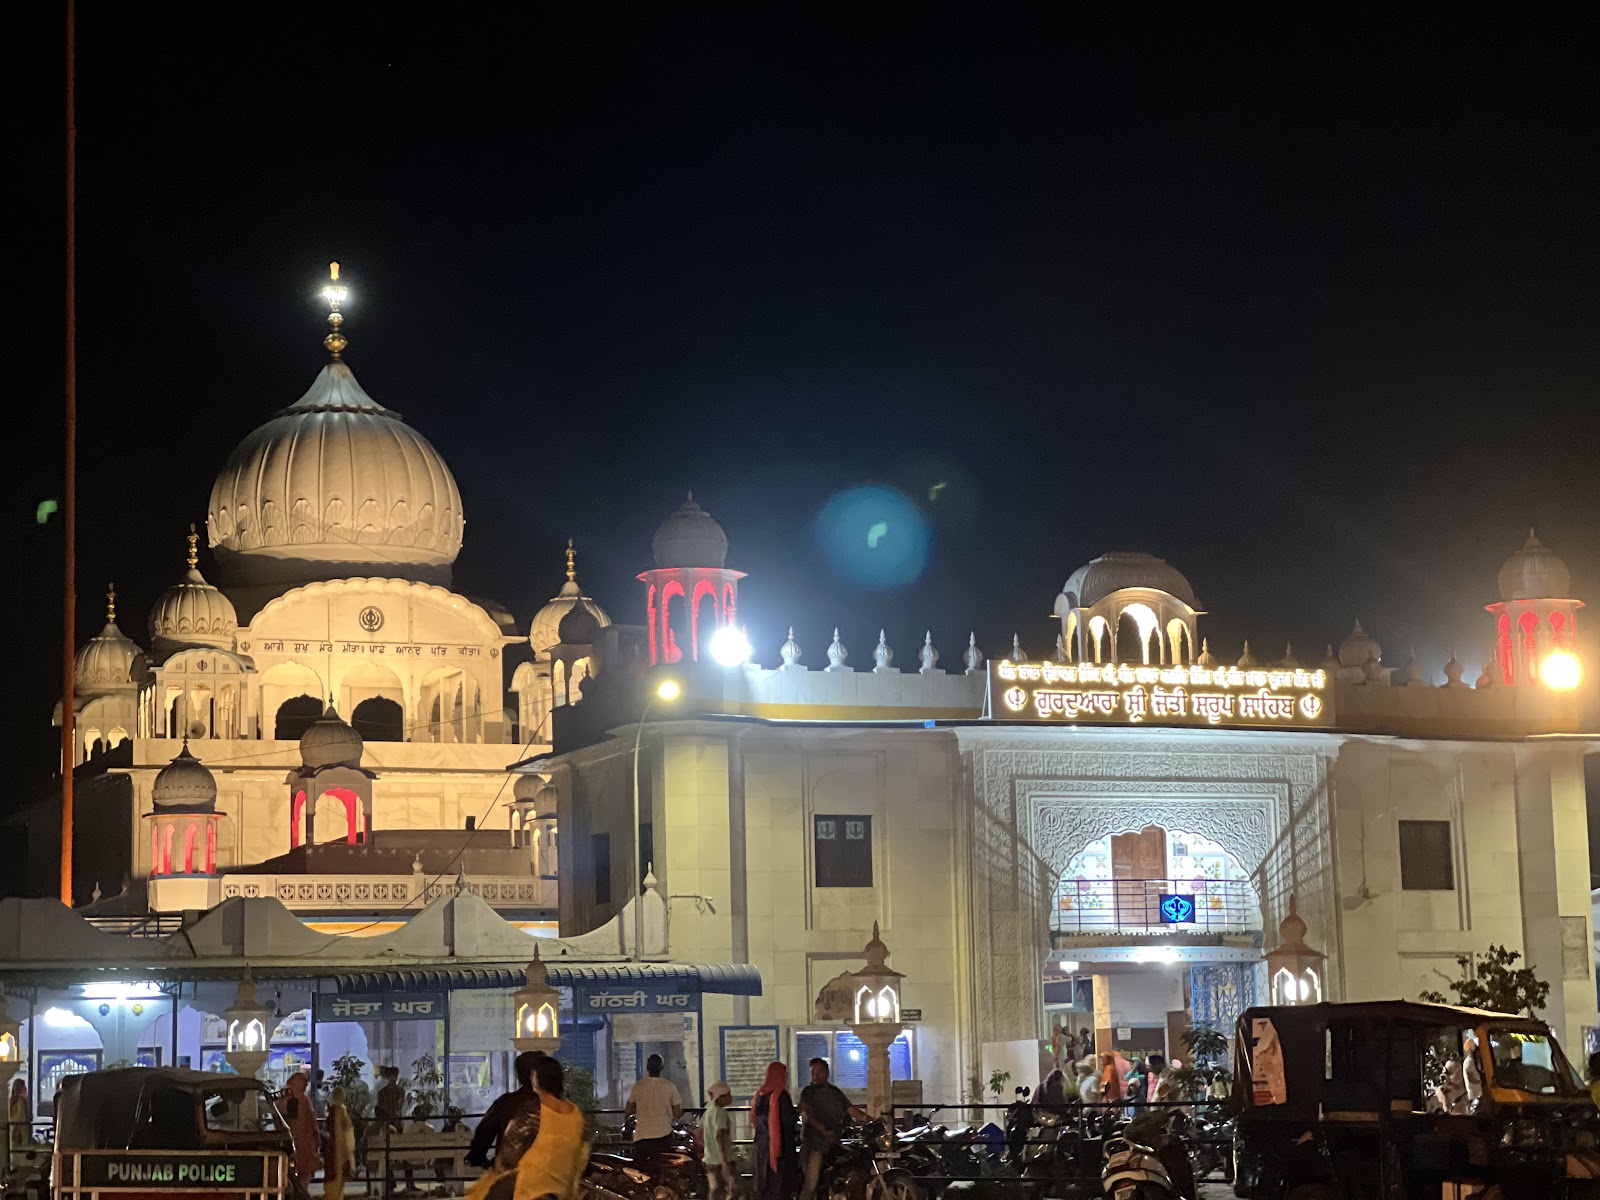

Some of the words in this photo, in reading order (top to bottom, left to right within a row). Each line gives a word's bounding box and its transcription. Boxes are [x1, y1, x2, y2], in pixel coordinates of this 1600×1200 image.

[319, 641, 333, 652] ਮੇਰੇ
[1034, 690, 1120, 717] ਗੁਰਦੁਆਰਾ
[1125, 686, 1148, 722] ਸ੍ਰੀ
[1151, 687, 1188, 716] ਜੋਤੀ
[1192, 693, 1235, 724] ਸਰੂਪ
[1240, 688, 1294, 717] ਸਾਹਿਬ
[332, 998, 382, 1016] ਜੋੜਾ
[393, 1001, 434, 1014] ਘਰ
[589, 990, 648, 1008] ਗੱਠੜੀ
[656, 994, 690, 1006] ਘਰ
[107, 1163, 174, 1181] PUNJAB
[178, 1164, 236, 1181] POLICE
